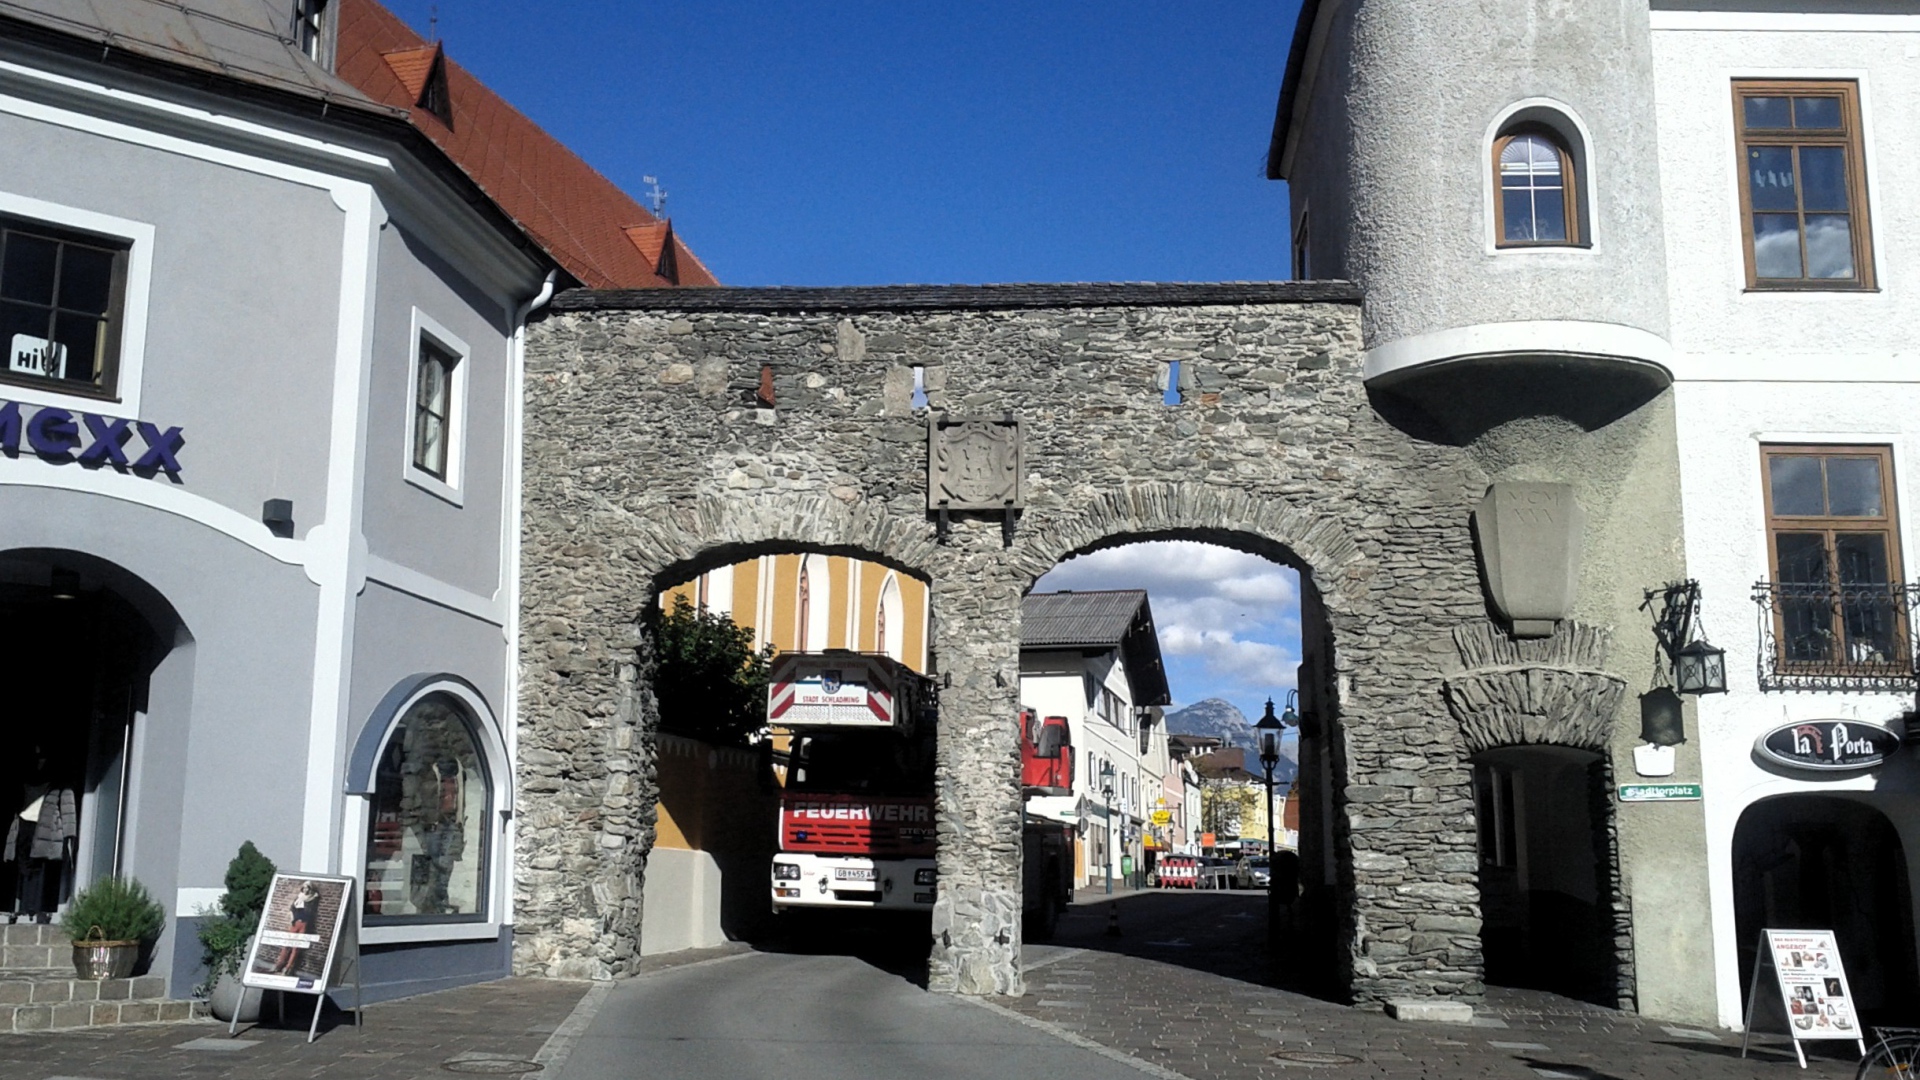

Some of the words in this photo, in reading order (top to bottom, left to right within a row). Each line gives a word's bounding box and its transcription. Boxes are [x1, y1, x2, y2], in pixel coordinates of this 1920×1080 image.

[802, 695, 819, 703] STADT
[821, 695, 860, 704] SCHLADMING
[793, 801, 929, 822] FEUERWEHR
[899, 827, 936, 836] STEYR
